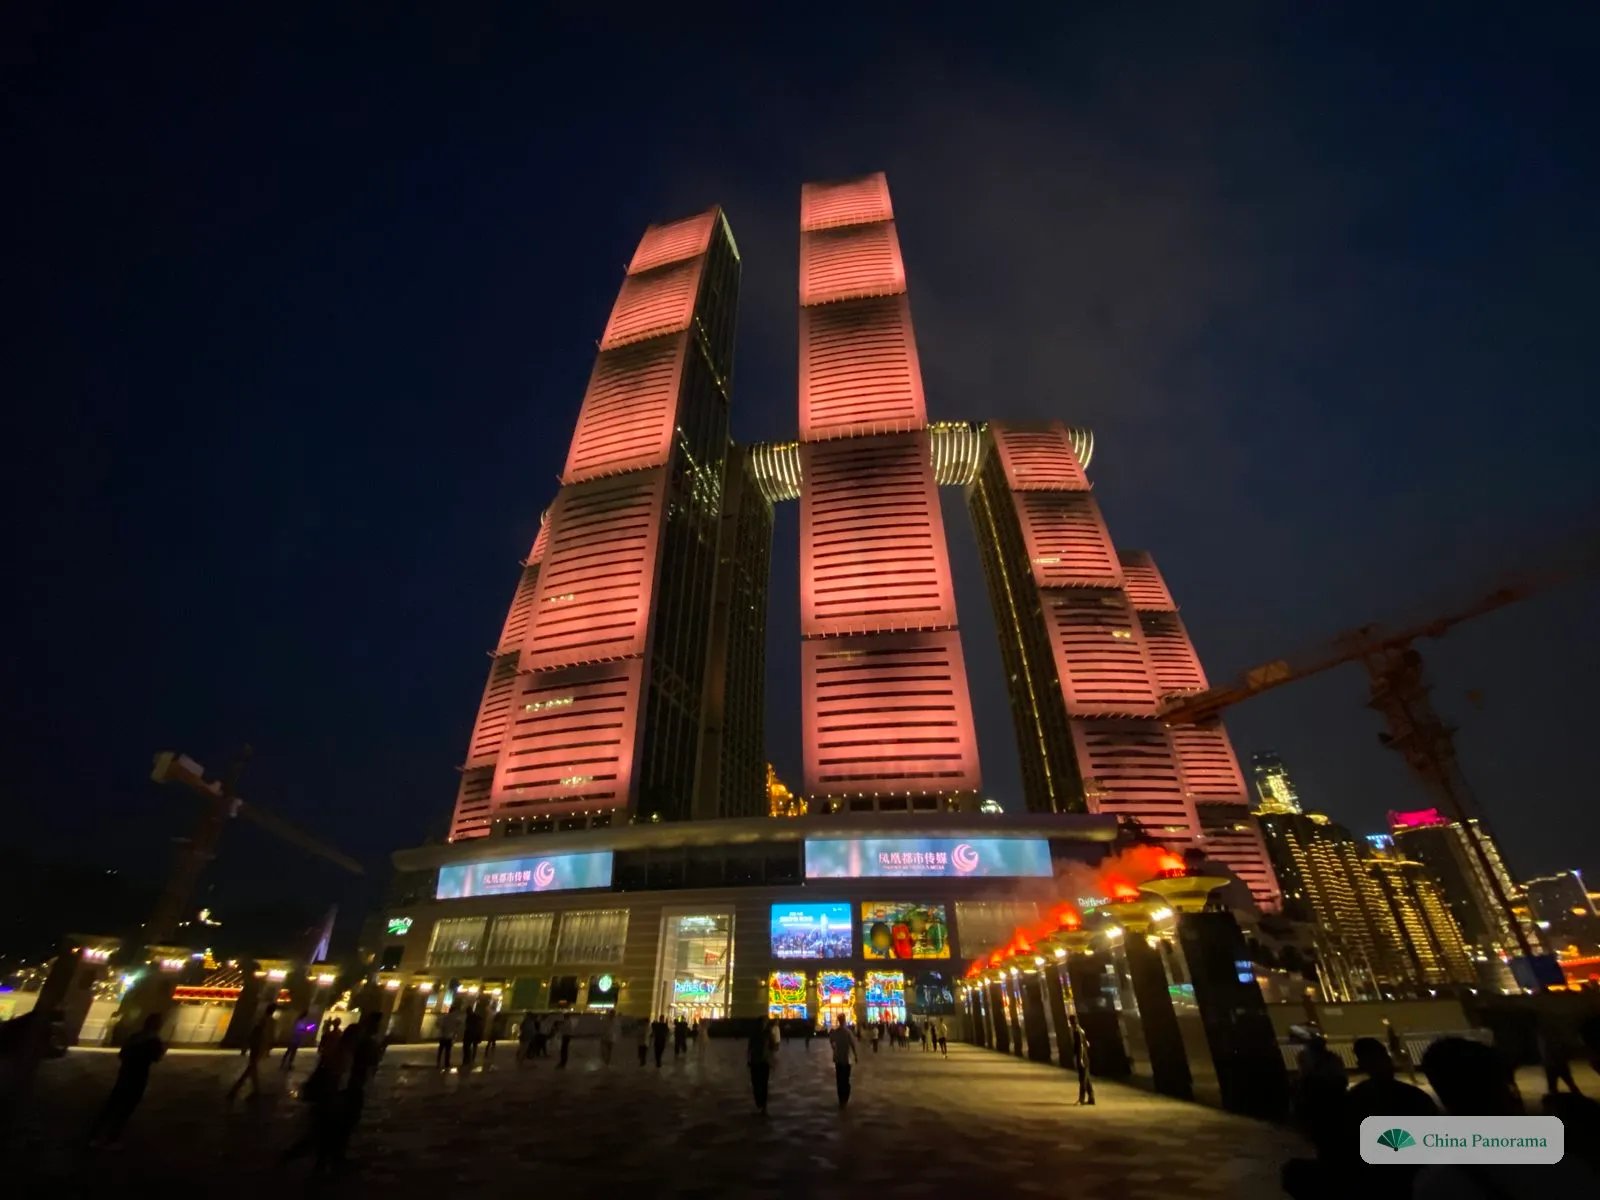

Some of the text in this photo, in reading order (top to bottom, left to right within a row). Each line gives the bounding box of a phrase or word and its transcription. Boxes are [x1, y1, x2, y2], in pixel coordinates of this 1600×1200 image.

[879, 852, 947, 864] 凤凰都市传媒
